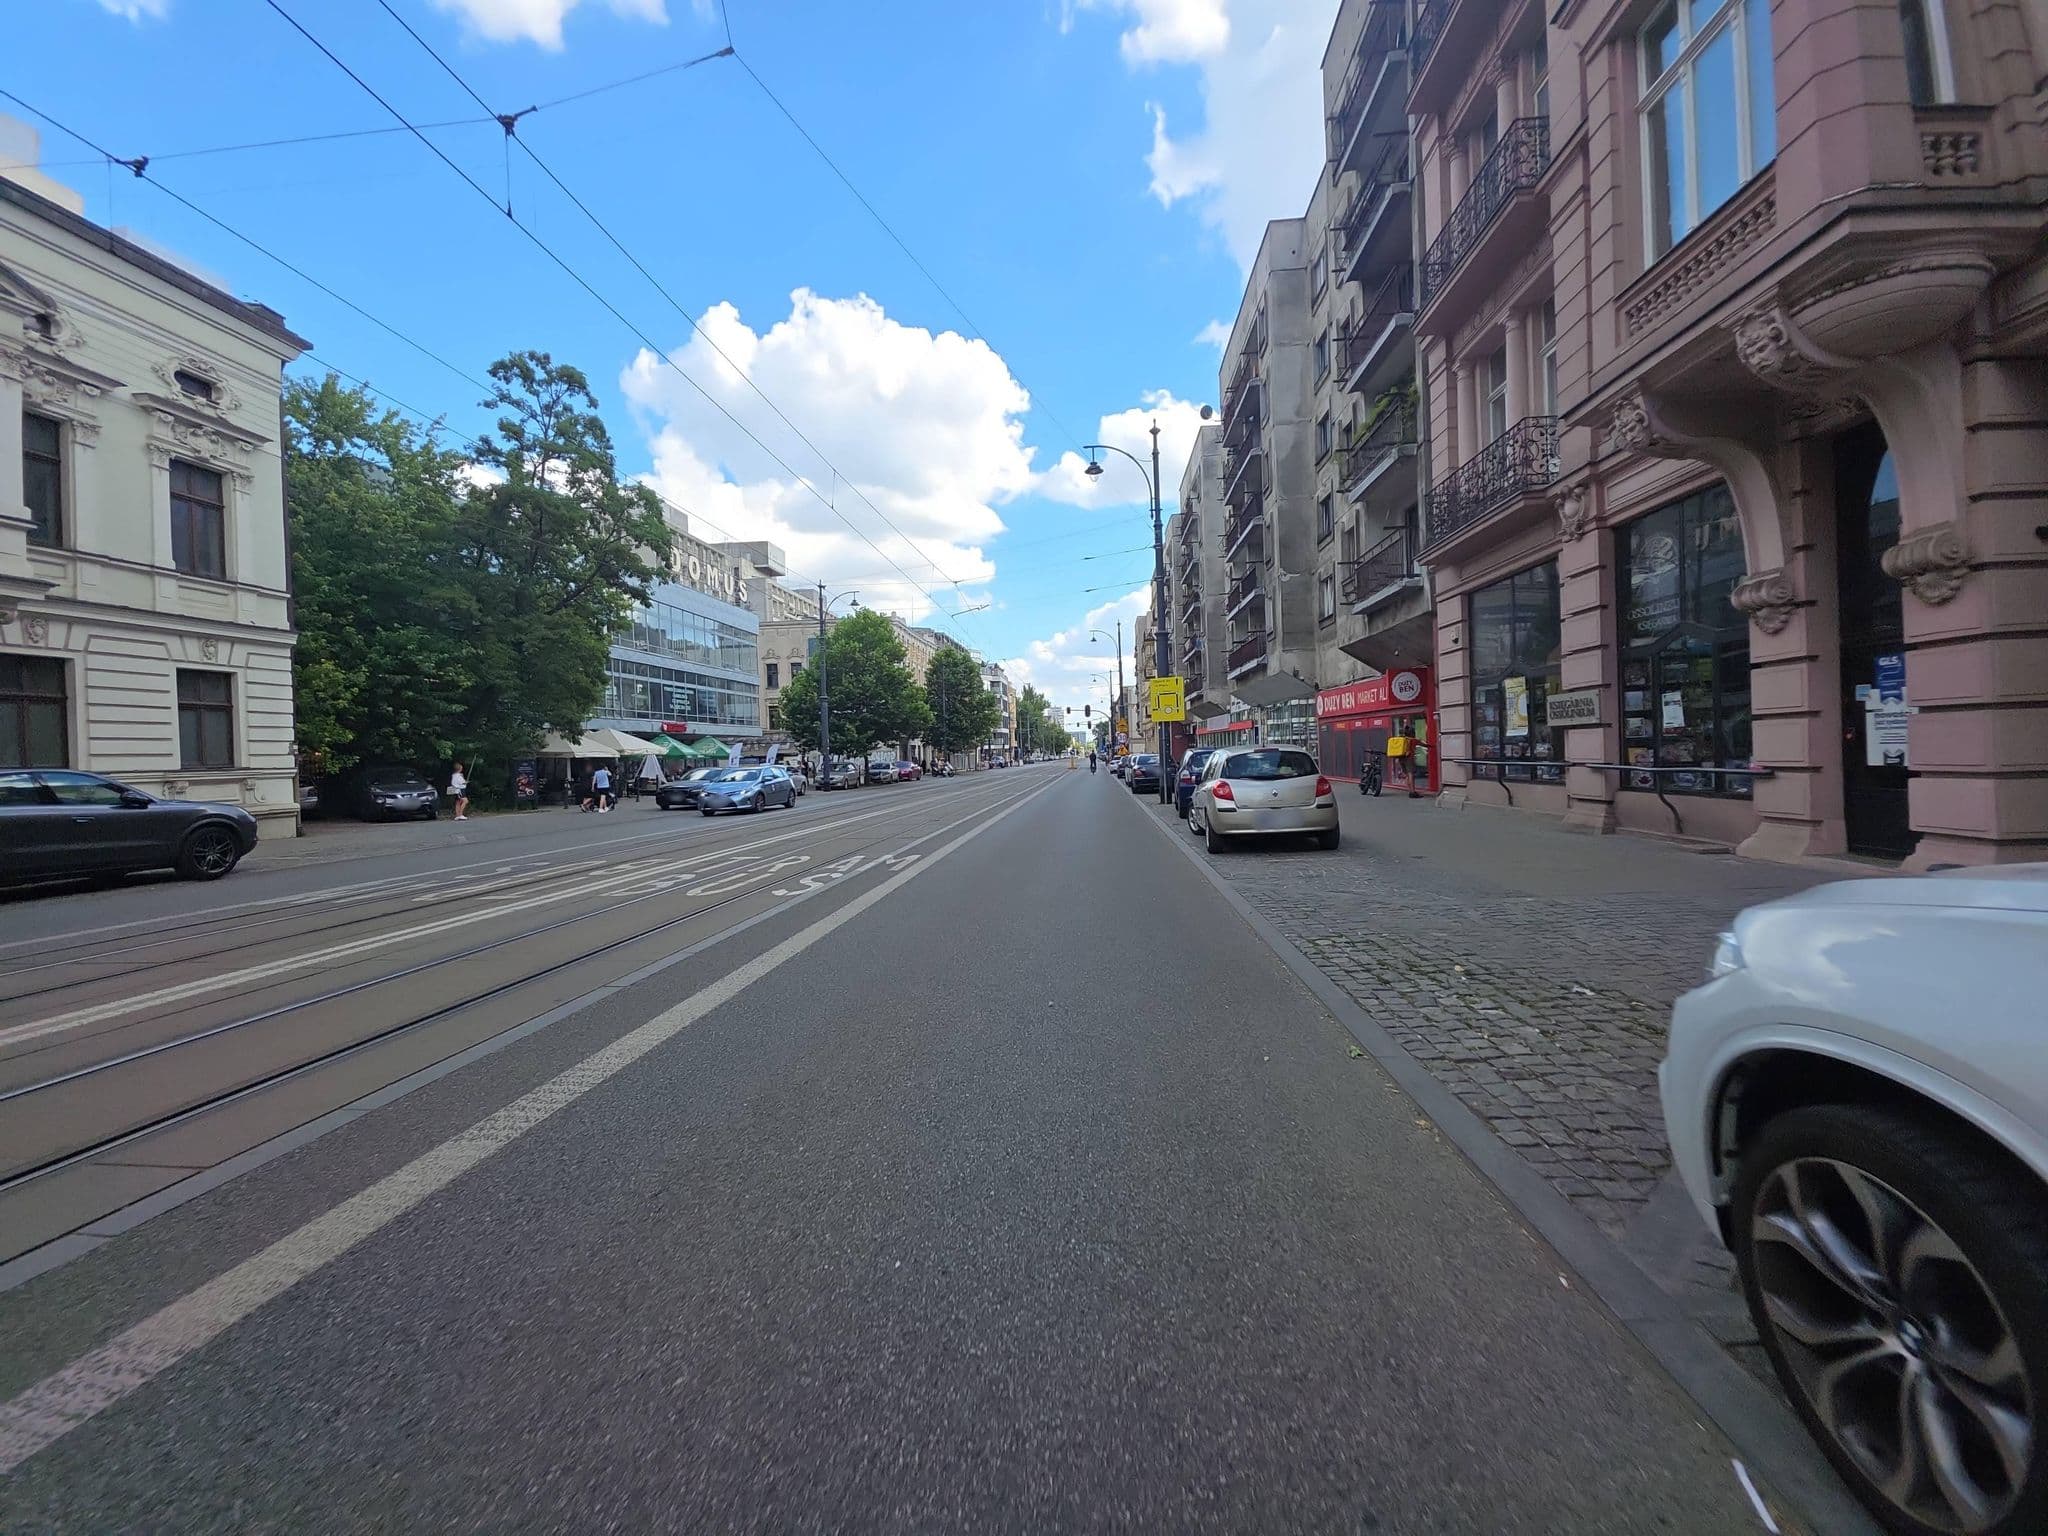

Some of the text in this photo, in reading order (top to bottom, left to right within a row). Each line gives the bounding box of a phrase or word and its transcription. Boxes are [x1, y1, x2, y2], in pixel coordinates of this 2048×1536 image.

[670, 545, 748, 602] DOMUS
[1341, 691, 1355, 709] BEN
[1357, 688, 1377, 705] MARKET
[1399, 684, 1415, 693] BEN
